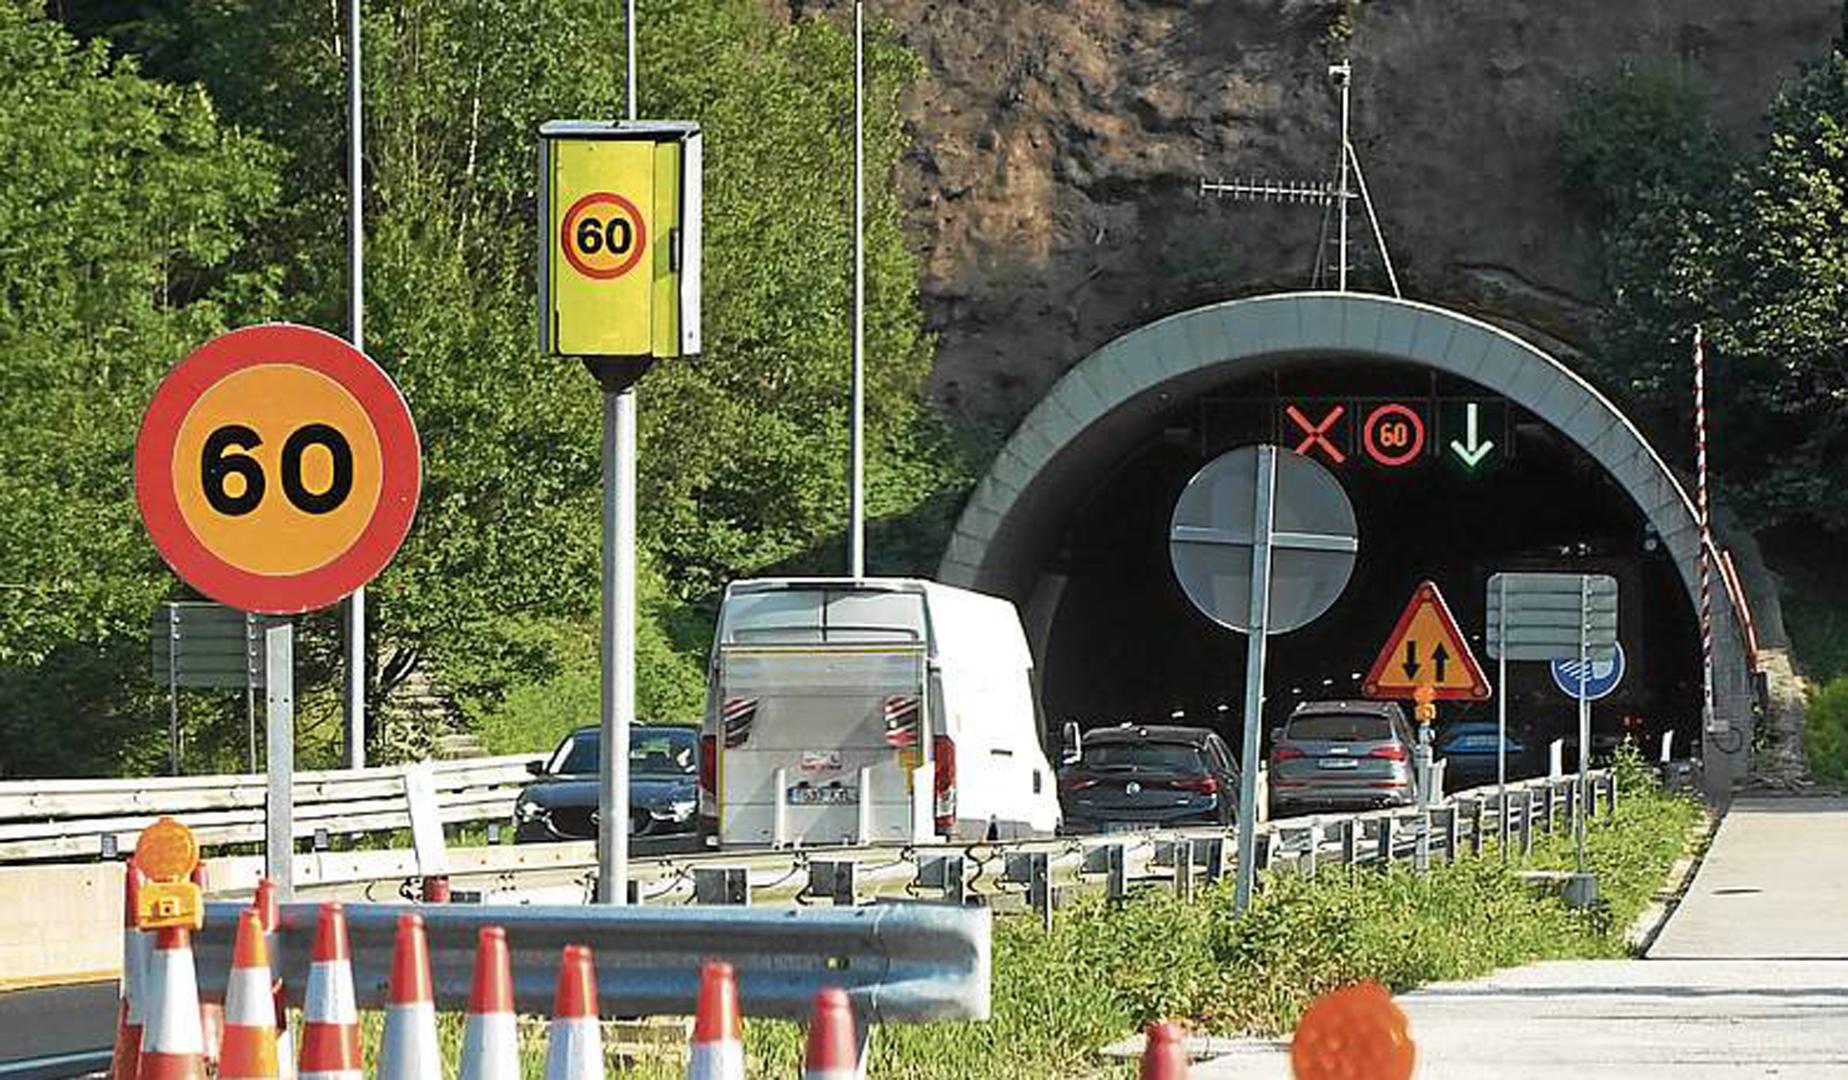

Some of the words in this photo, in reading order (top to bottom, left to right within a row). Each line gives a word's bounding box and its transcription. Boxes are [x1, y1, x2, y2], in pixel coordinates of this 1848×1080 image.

[577, 217, 631, 255] 60
[1380, 423, 1408, 447] 60
[201, 423, 353, 515] 60
